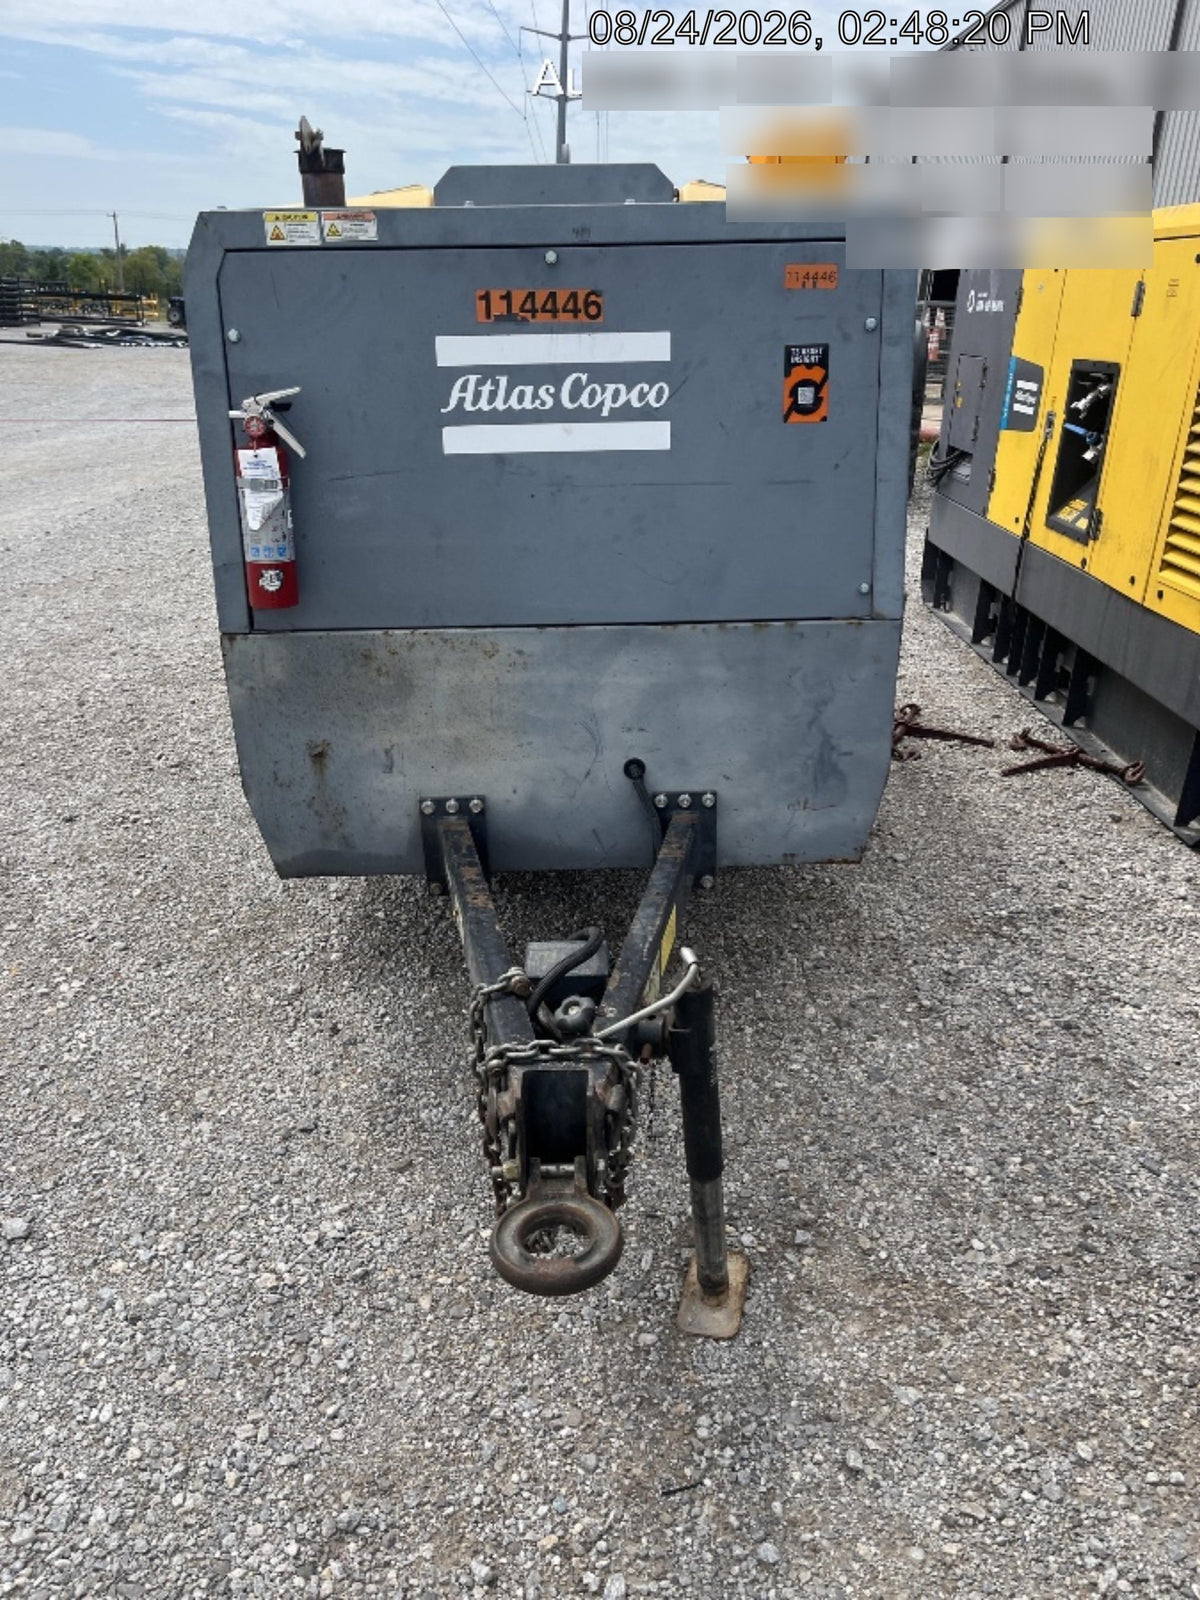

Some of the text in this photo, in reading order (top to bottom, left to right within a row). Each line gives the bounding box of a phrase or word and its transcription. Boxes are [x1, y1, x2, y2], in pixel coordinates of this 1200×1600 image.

[477, 290, 602, 320] 114446
[440, 372, 670, 417] Atlas Copco
